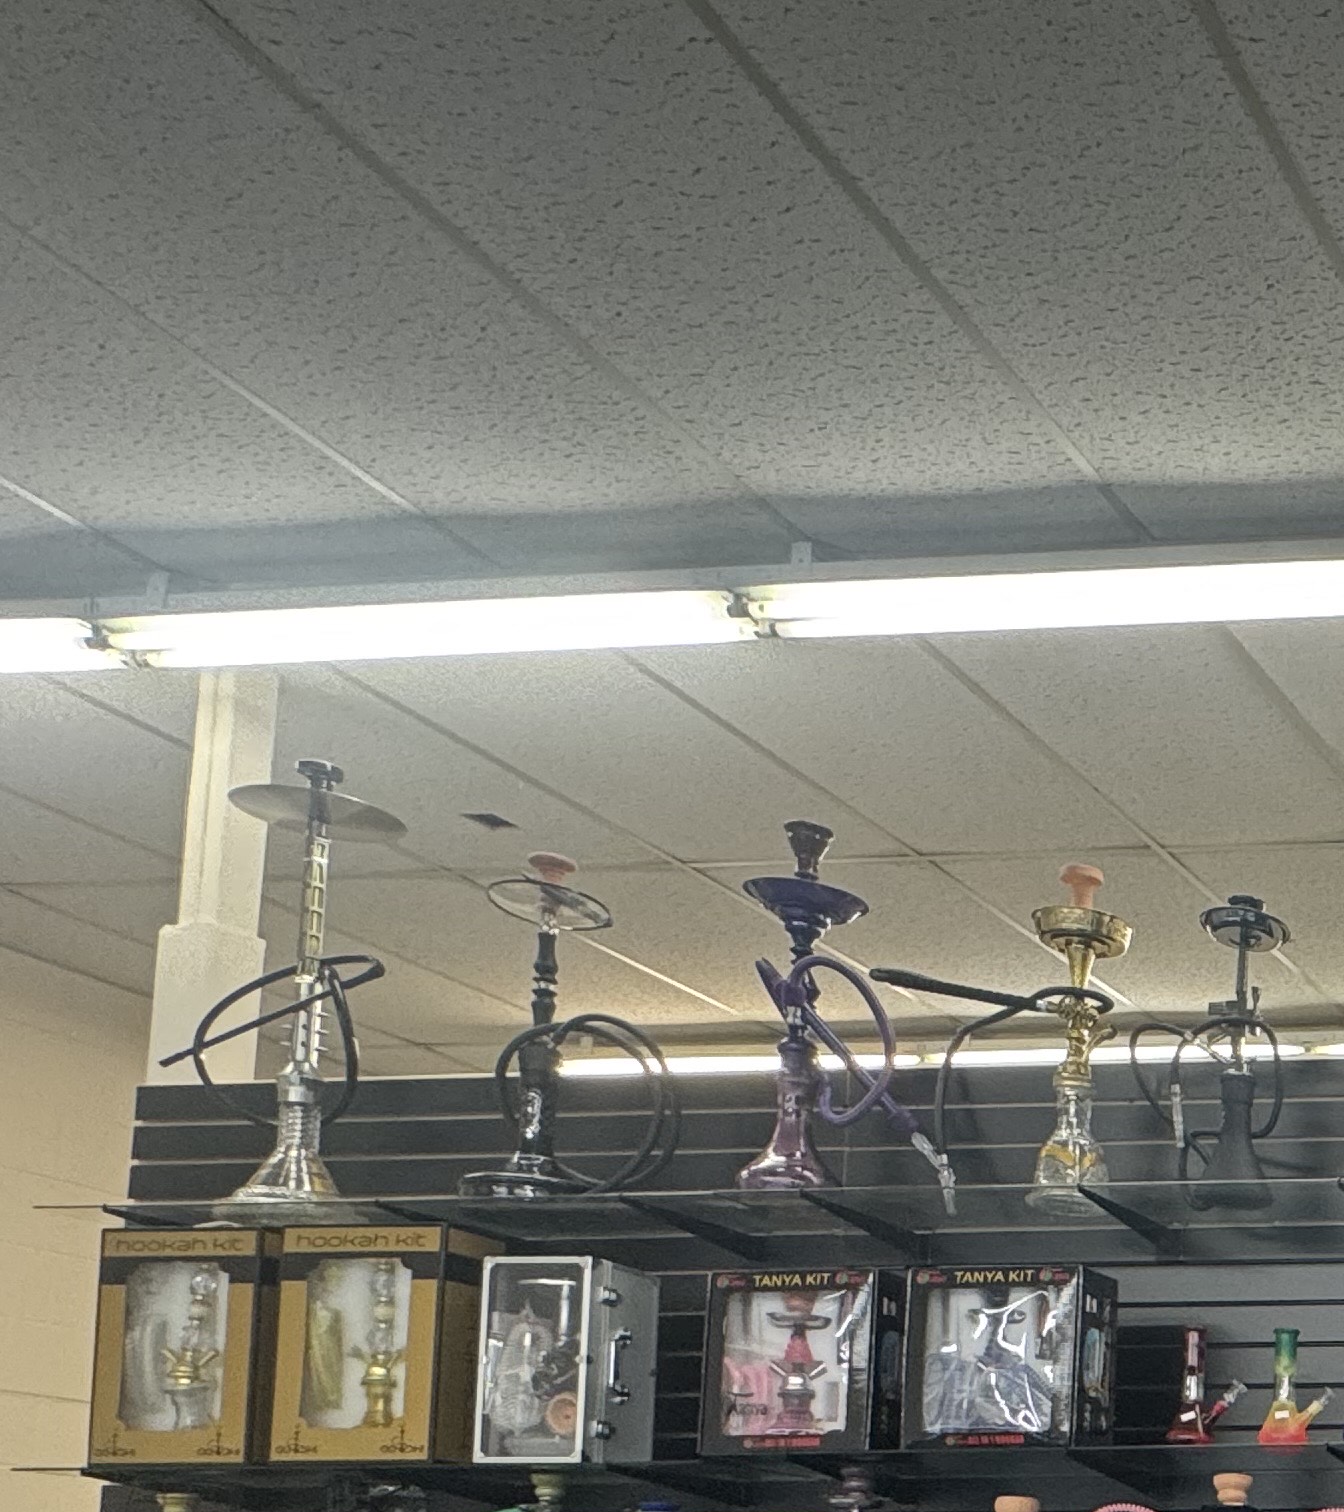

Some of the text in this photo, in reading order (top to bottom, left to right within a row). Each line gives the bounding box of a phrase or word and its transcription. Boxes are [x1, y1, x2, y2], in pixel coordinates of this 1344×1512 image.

[116, 1237, 243, 1252] hookah kit
[296, 1232, 427, 1248] hookah kit
[753, 1273, 802, 1288] TANYA
[806, 1272, 831, 1286] KIT
[954, 1269, 1035, 1284] TANYA KIT
